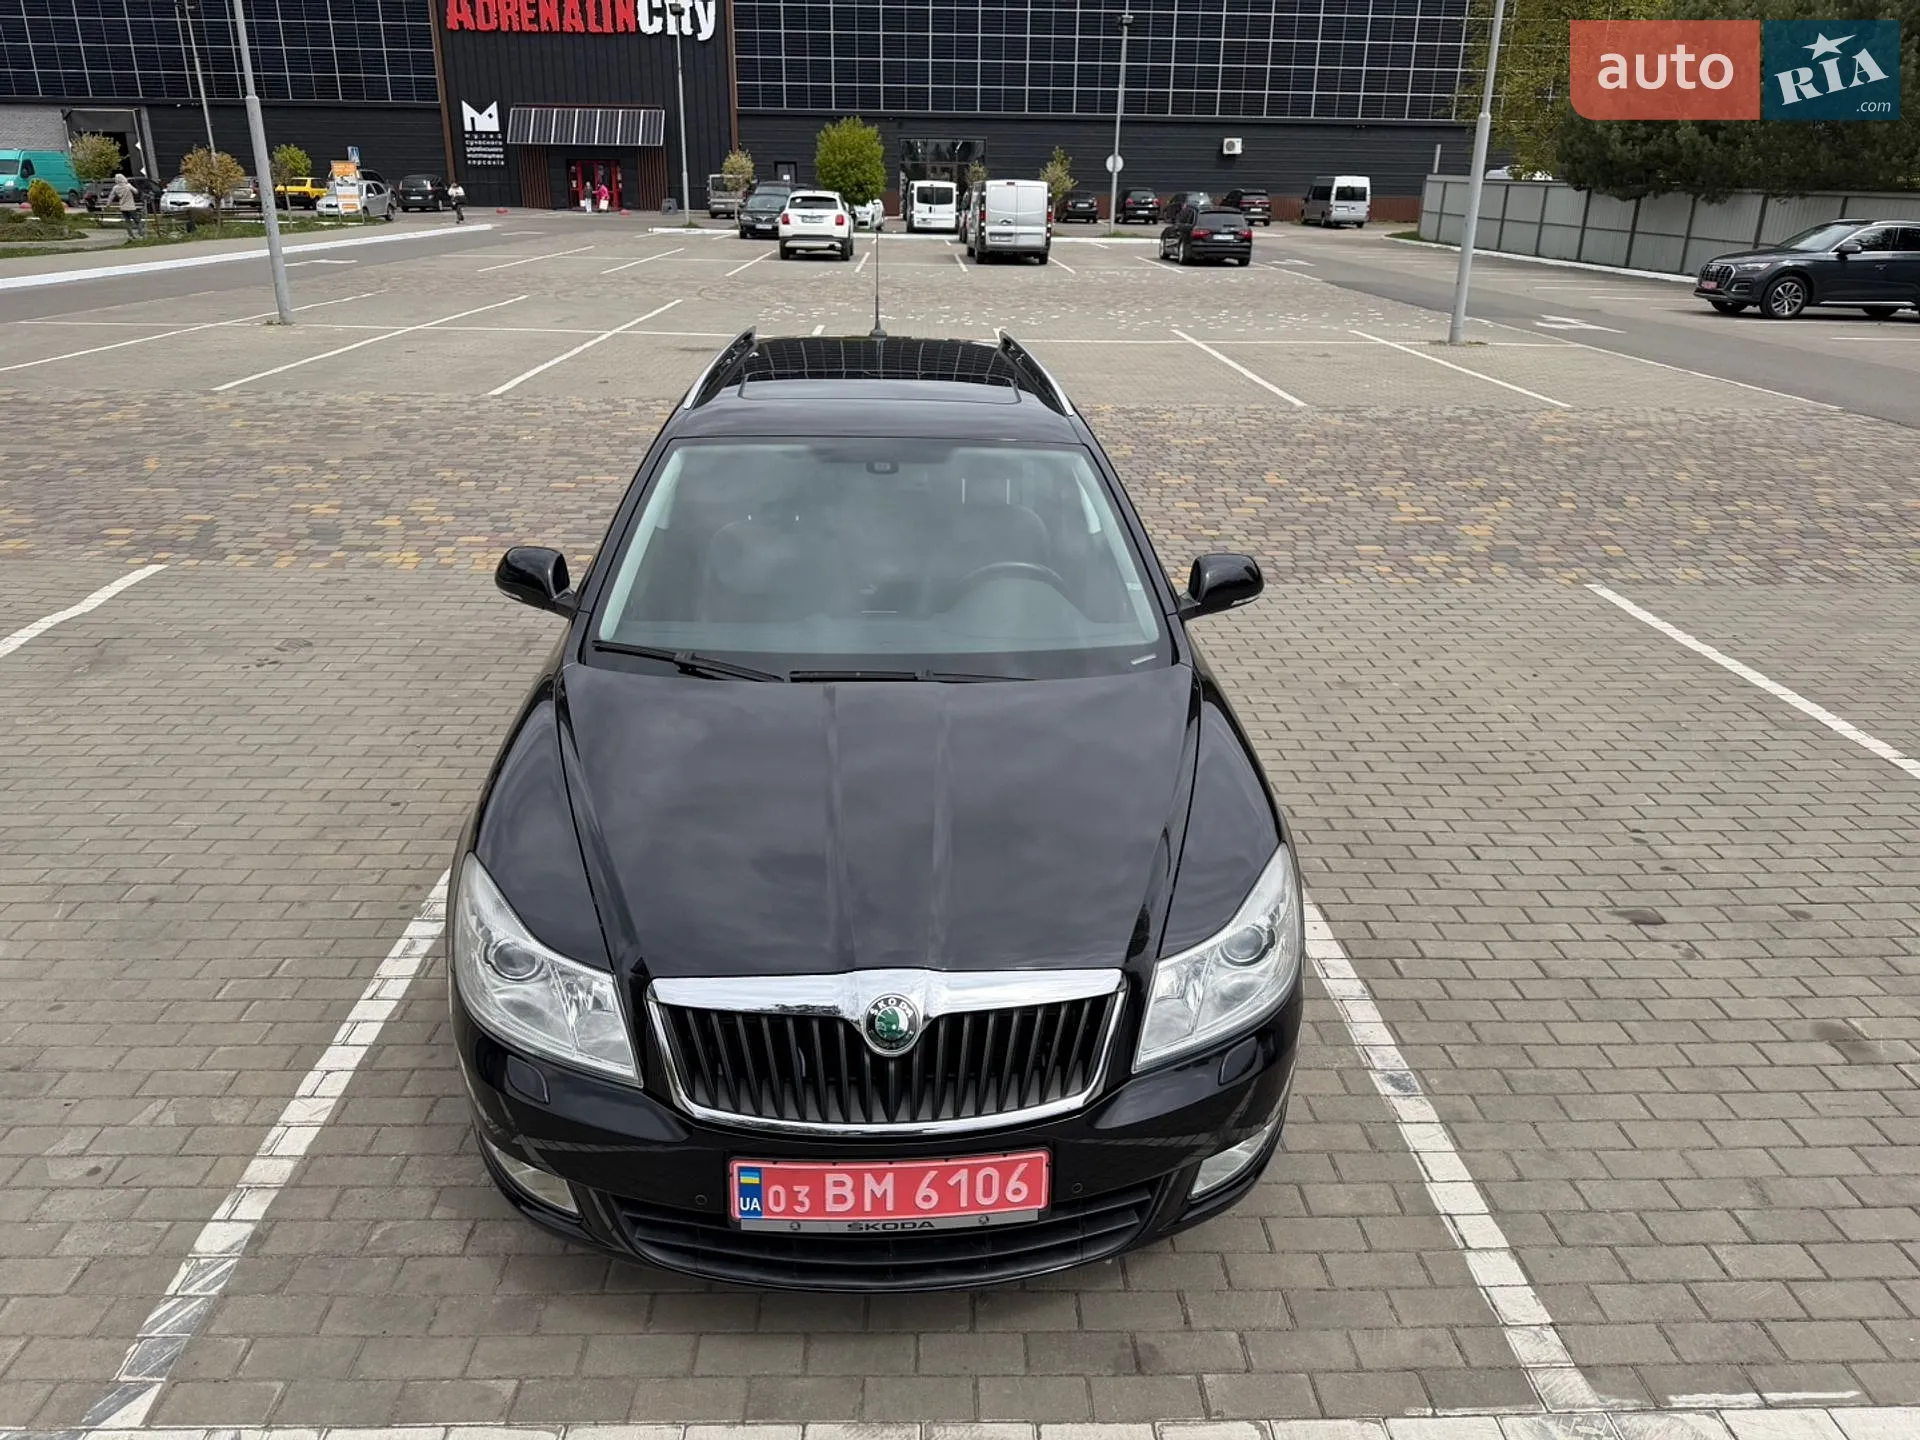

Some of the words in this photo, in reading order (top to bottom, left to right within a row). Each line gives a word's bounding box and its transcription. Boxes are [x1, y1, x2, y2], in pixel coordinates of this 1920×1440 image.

[767, 1185, 811, 1213] 03
[825, 1172, 894, 1213] BM
[914, 1162, 1029, 1210] 6106
[739, 1197, 762, 1212] UA
